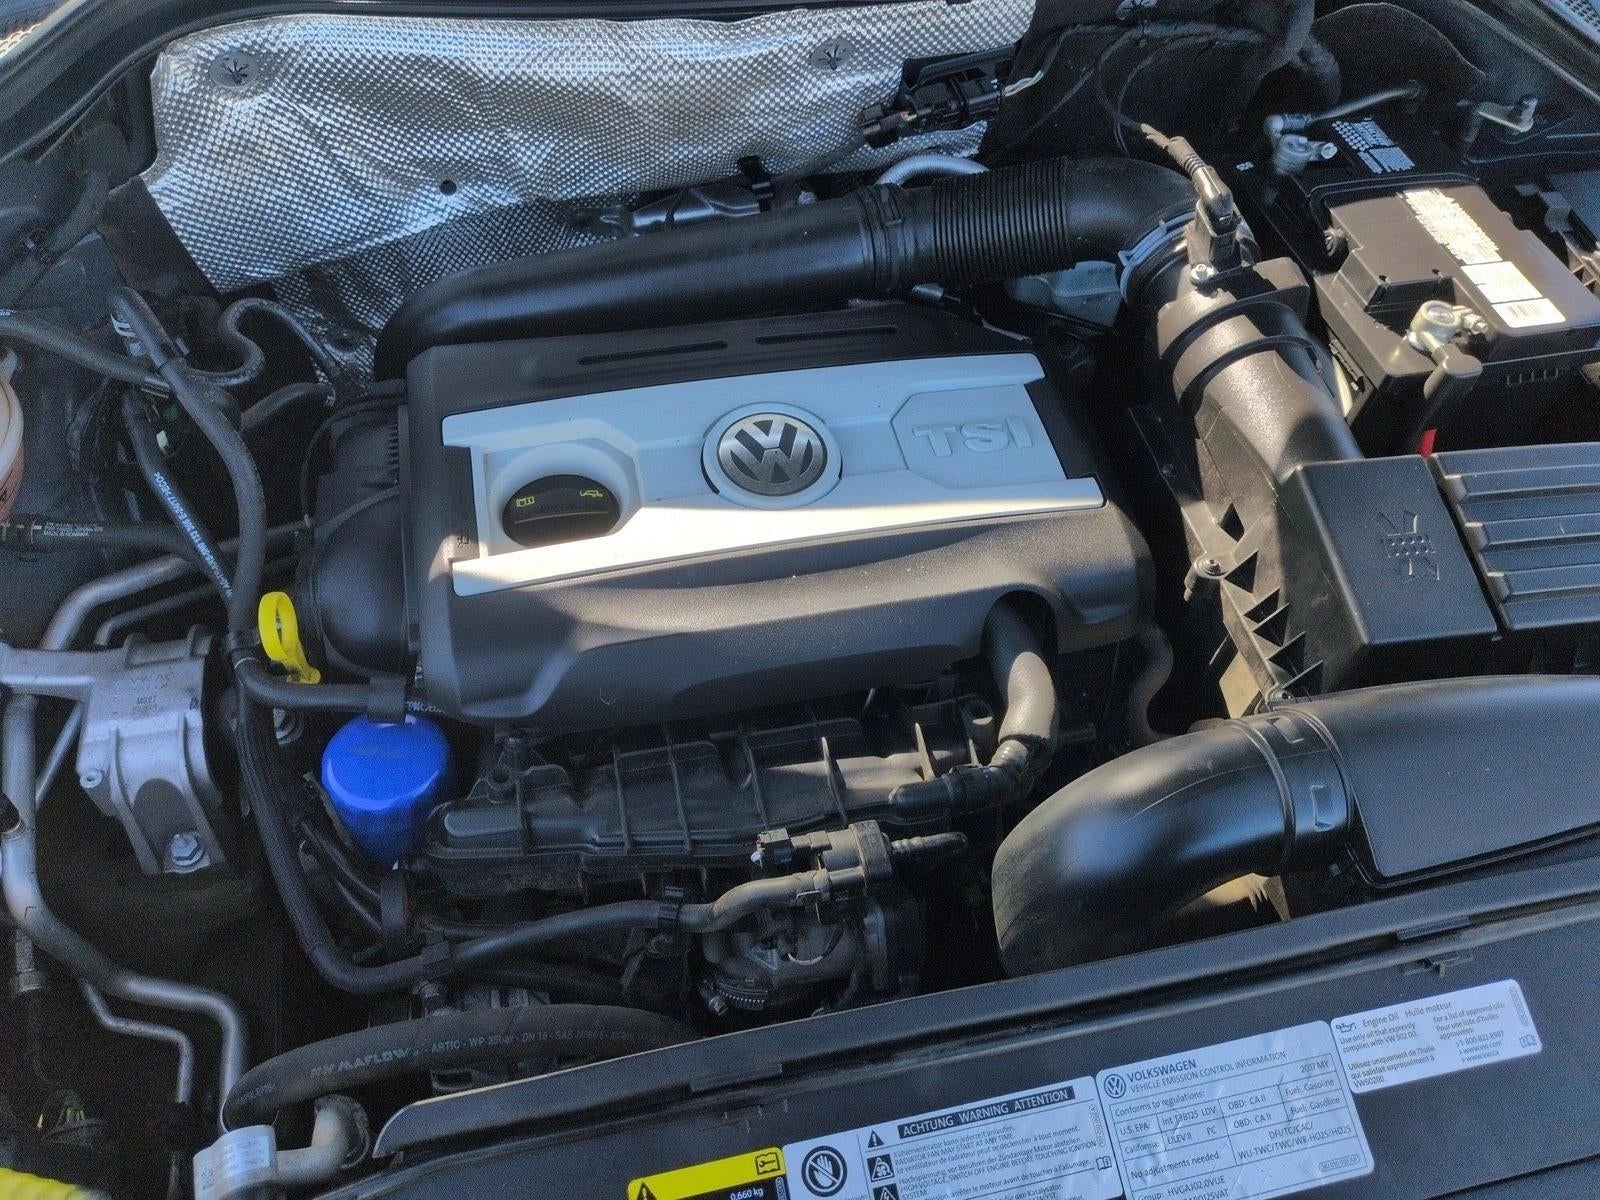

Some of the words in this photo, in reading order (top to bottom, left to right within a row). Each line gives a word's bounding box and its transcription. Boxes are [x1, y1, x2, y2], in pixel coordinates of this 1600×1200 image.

[913, 415, 1034, 458] TSI
[1362, 1017, 1388, 1028] Engine
[1388, 1012, 1400, 1021] Oil
[1405, 1007, 1425, 1018] Huile
[1425, 1002, 1451, 1012] moteur
[1433, 1015, 1442, 1023] For
[1448, 1012, 1458, 1020] list
[1465, 1005, 1492, 1016] approved
[1340, 1037, 1352, 1045] Use
[1352, 1033, 1366, 1043] only
[1375, 1028, 1388, 1036] that
[1388, 1022, 1416, 1033] expressly
[1436, 1024, 1451, 1032] Pour
[1342, 1042, 1369, 1053] complies
[1370, 1039, 1384, 1047] with
[1127, 1059, 1197, 1082] VOLKSWAGEN
[1300, 1062, 1317, 1073] 2017
[1317, 1060, 1329, 1069] MY
[1371, 1052, 1408, 1066] uniquement
[1130, 1080, 1161, 1093] VEHICLE
[1161, 1071, 1199, 1086] EMISSION
[1199, 1061, 1235, 1078] CONTROL
[1235, 1050, 1286, 1069] INFORMATION
[1351, 1072, 1362, 1080] qui
[1115, 1103, 1151, 1117] Conforms
[1152, 1101, 1160, 1109] to
[1161, 1091, 1205, 1107] regulations:
[1201, 1106, 1216, 1117] LDV
[1249, 1096, 1259, 1105] CA
[1285, 1086, 1301, 1096] Fuel:
[1304, 1078, 1335, 1091] Gasoline
[903, 1115, 954, 1136] ACHTUNG
[959, 1102, 1009, 1123] WARNING
[1014, 1090, 1068, 1111] ATTENTION
[1125, 1141, 1160, 1155] California:
[1166, 1134, 1187, 1145] ULEV
[1206, 1126, 1217, 1135] PC
[1255, 1115, 1265, 1124] CA
[1310, 1096, 1341, 1110] Gasoline
[895, 1153, 926, 1166] RADIATOR
[927, 1150, 940, 1159] FAN
[941, 1146, 955, 1156] MAY
[956, 1140, 975, 1151] START
[976, 1139, 984, 1147] AT
[985, 1137, 997, 1145] ANY
[948, 1151, 976, 1163] radiateur
[977, 1146, 991, 1159] peut
[992, 1144, 1000, 1152] se
[1038, 1132, 1051, 1141] tout
[988, 1155, 998, 1164] der
[1034, 1143, 1053, 1153] Motor
[900, 1183, 919, 1193] HIGH
[949, 1170, 973, 1182] SWITCH
[974, 1166, 986, 1176] OFF
[986, 1162, 1010, 1173] ENGINE
[1011, 1155, 1034, 1167] BEFORE
[1035, 1147, 1069, 1162] TOUCHING
[1069, 1140, 1097, 1153] IGNITION
[1131, 1170, 1143, 1180] No
[1144, 1159, 1191, 1176] adjustments
[1191, 1151, 1221, 1165] needed.
[979, 1180, 1003, 1190] moteur
[1003, 1176, 1020, 1185] avant
[1030, 1168, 1053, 1179] toucher
[753, 1188, 764, 1197] kg
[1014, 1190, 1027, 1200] den
